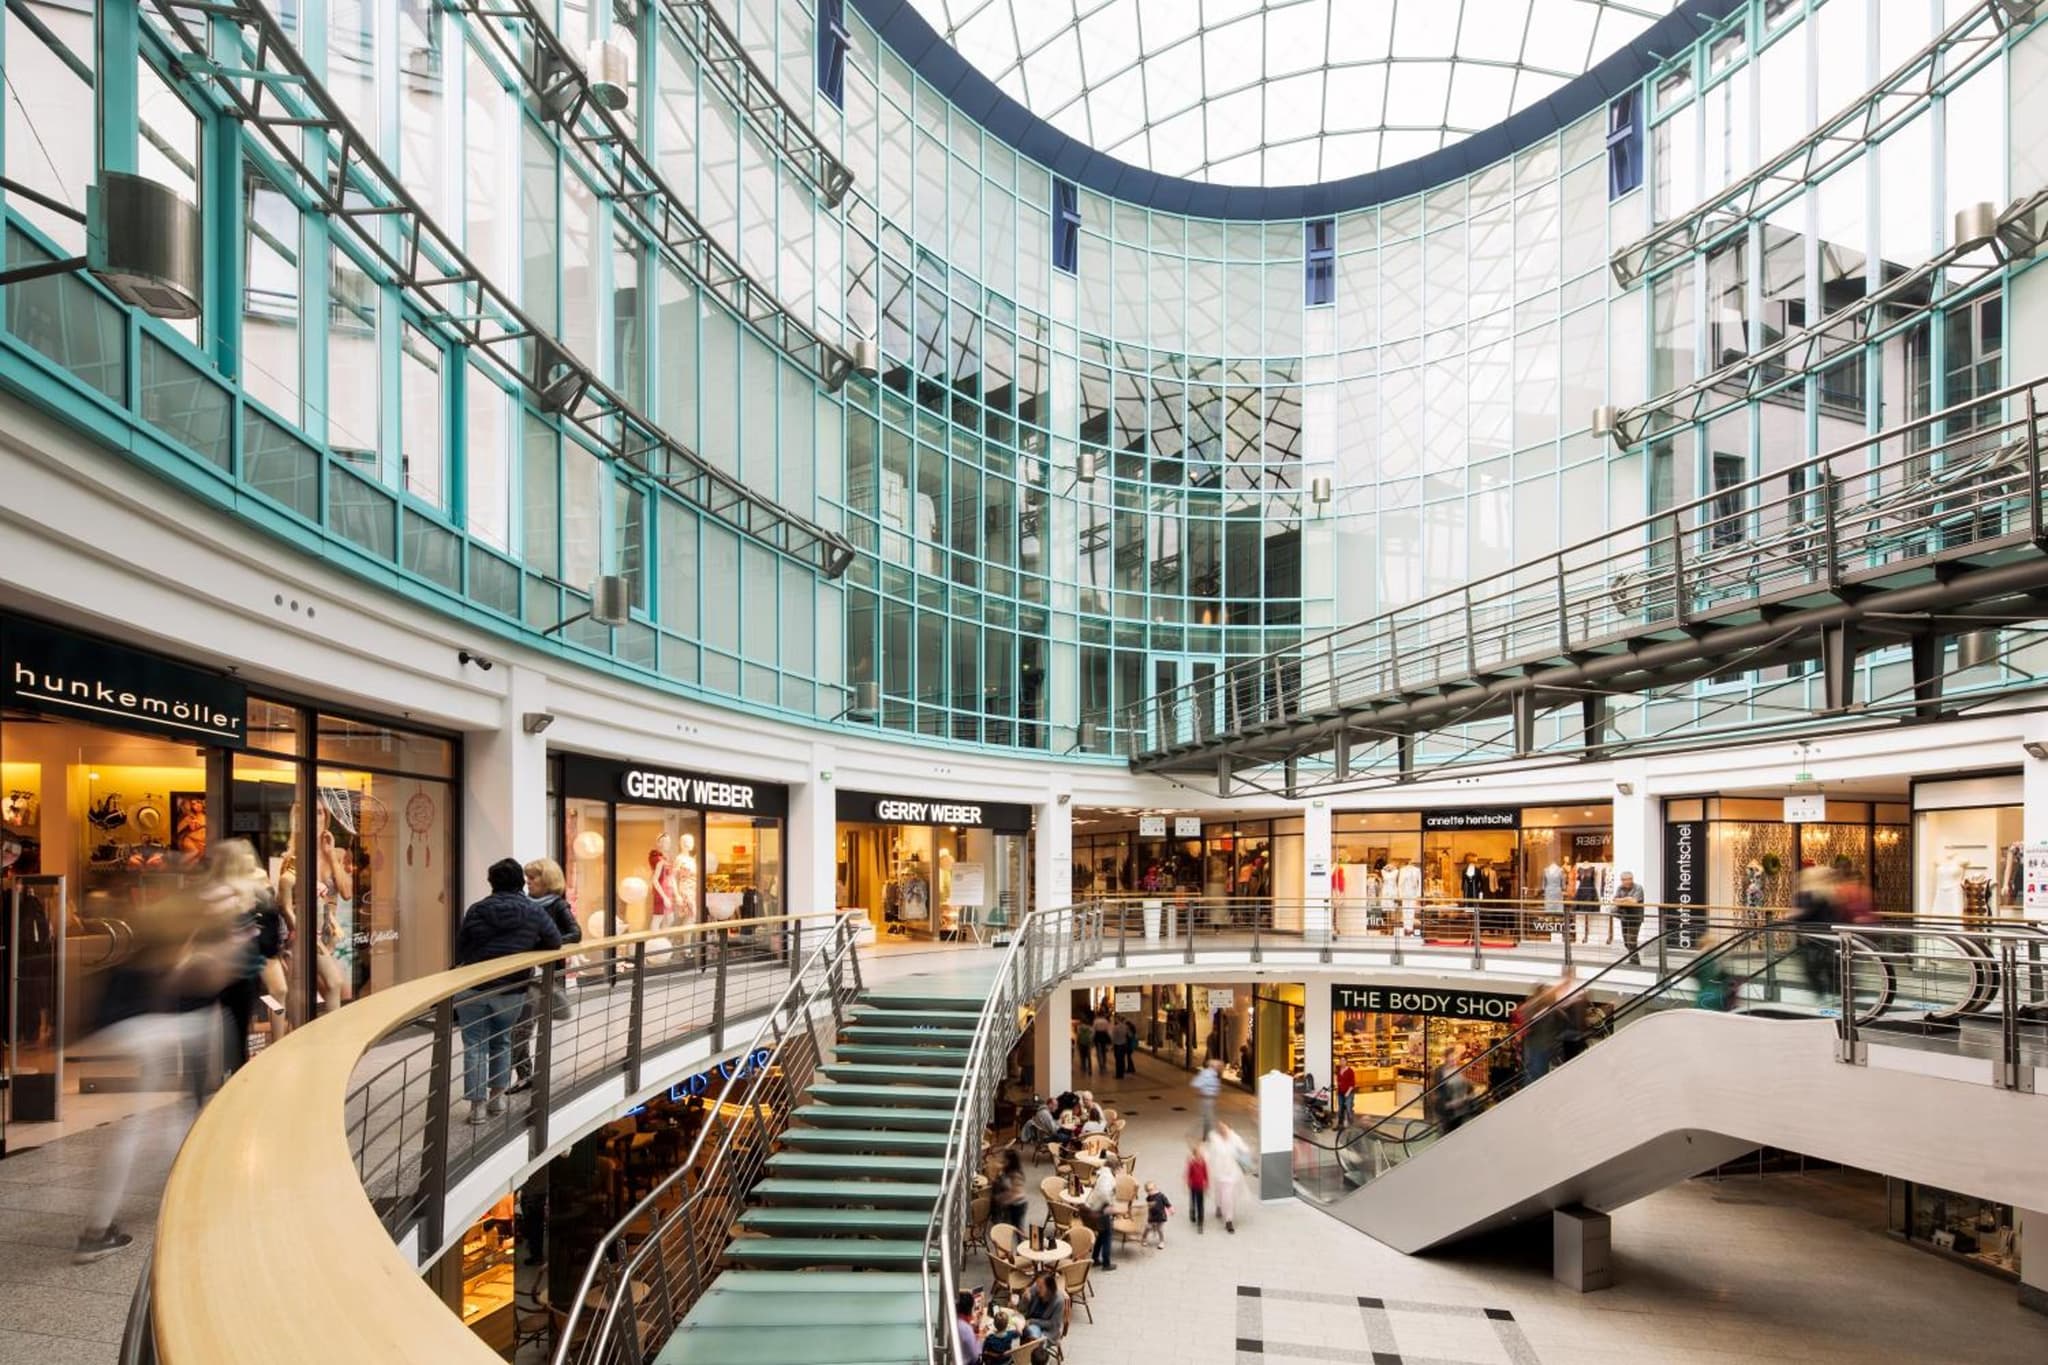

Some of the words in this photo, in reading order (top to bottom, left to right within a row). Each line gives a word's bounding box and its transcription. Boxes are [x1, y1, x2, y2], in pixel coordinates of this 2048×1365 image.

[15, 661, 241, 729] hunkemöller
[626, 770, 691, 802] GERRY
[692, 779, 754, 808] WEBER
[878, 800, 929, 821] GERRY
[930, 803, 982, 824] WEBER
[1427, 815, 1465, 826] annette
[1465, 813, 1513, 825] hentschel
[1676, 823, 1692, 891] hentschel
[1339, 989, 1381, 1009] THE
[1389, 992, 1451, 1013] BODY
[1456, 996, 1518, 1019] SHOP
